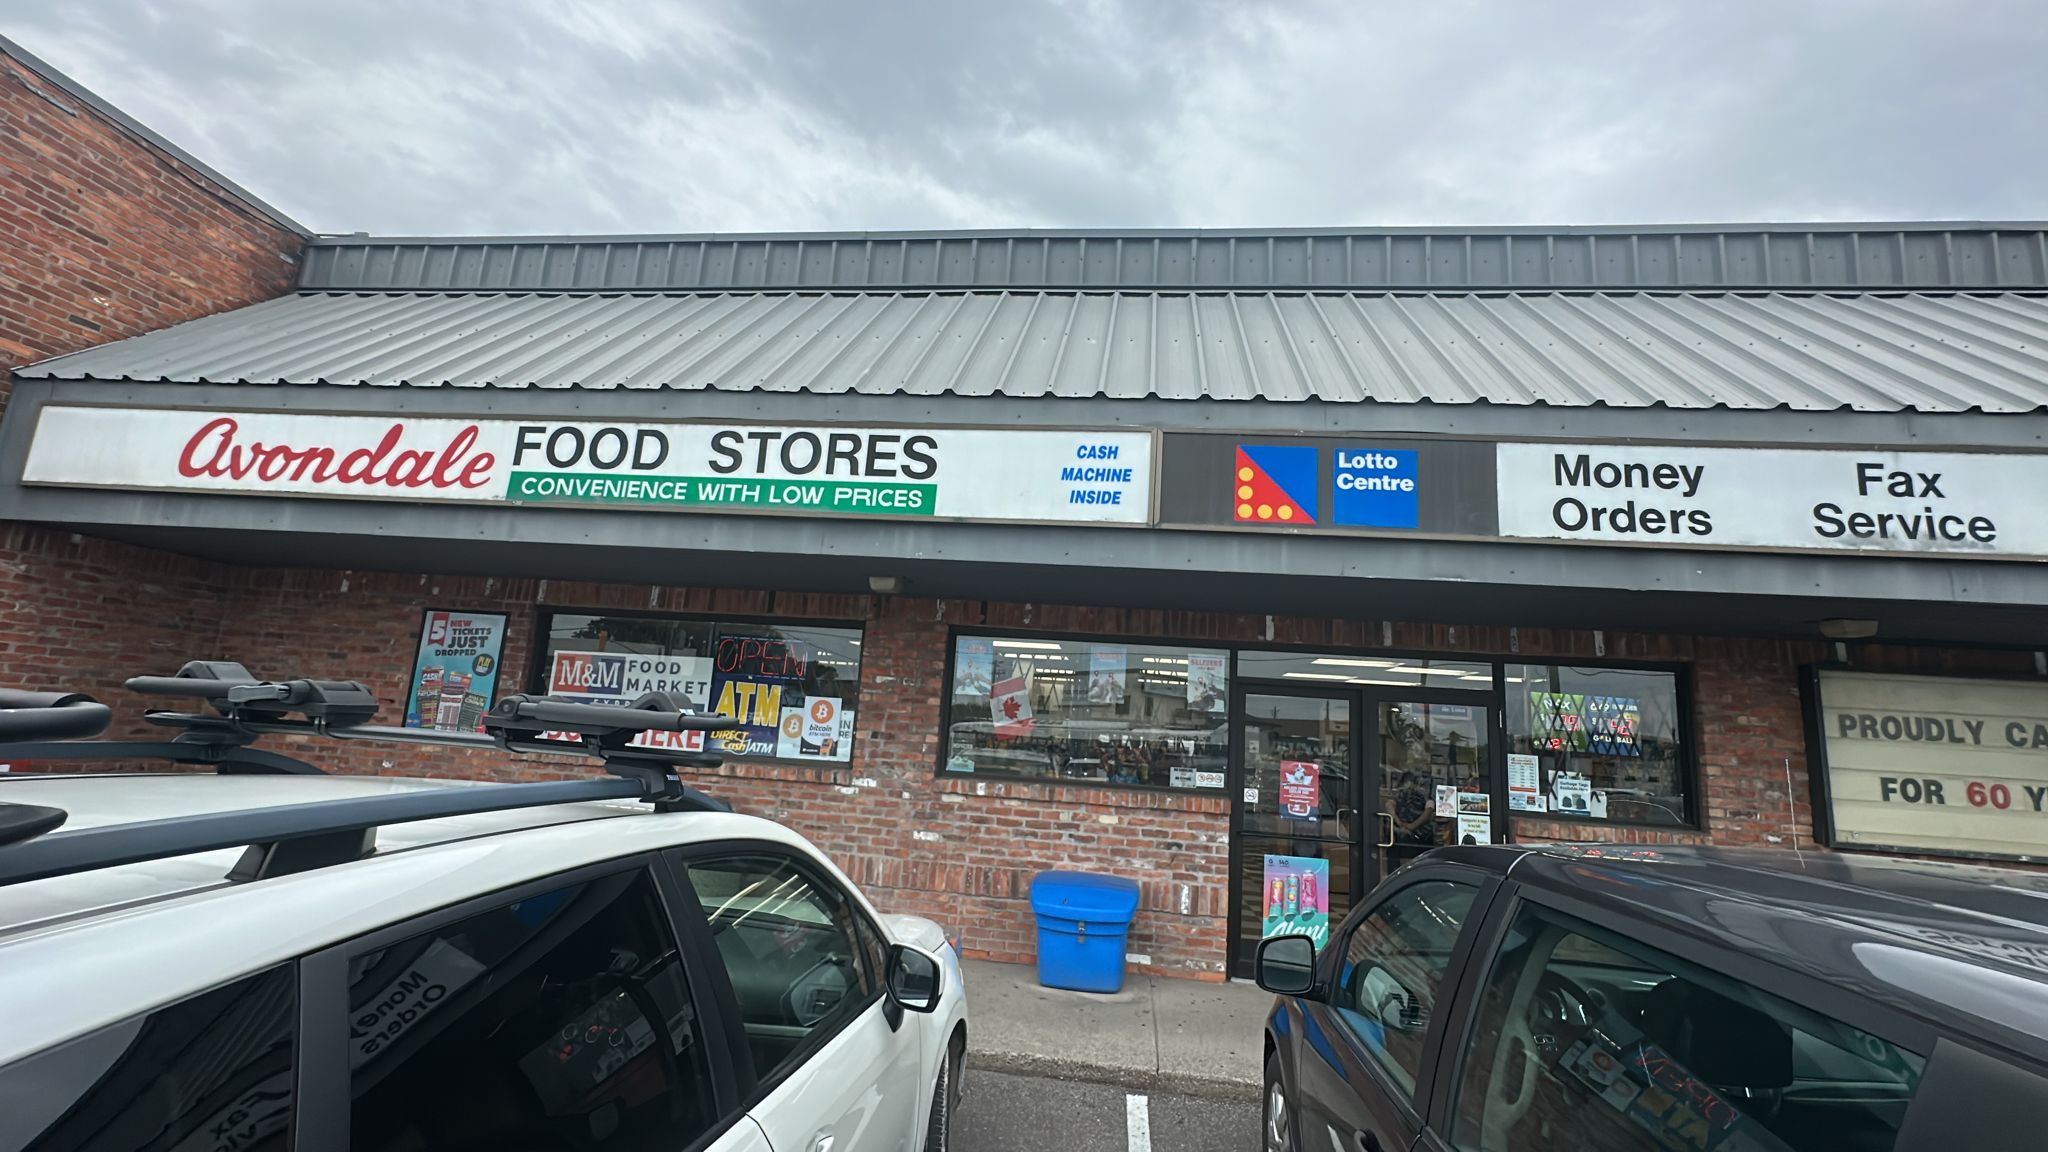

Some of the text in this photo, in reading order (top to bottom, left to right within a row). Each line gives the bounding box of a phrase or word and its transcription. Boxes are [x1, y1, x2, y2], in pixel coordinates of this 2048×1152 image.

[178, 417, 496, 489] Avondale
[512, 425, 938, 480] FOOD STORES
[1076, 445, 1119, 460] CASH
[1338, 452, 1398, 471] Lotto
[1061, 467, 1133, 483] MACHINE
[1336, 473, 1415, 493] Centre
[1554, 454, 1704, 498] Money
[1856, 462, 1946, 499] Fax
[520, 477, 923, 508] CONVENIENCE WITH LOW PRICES
[1069, 489, 1121, 506] INSIDE
[1552, 497, 1713, 535] Orders
[1812, 502, 1997, 543] Service
[430, 620, 446, 641] 5
[452, 628, 492, 636] TICKETS
[448, 636, 488, 649] JUST
[628, 660, 681, 675] FOOD
[717, 639, 806, 677] OPEN
[558, 660, 621, 688] M&M
[626, 678, 707, 695] MARKET
[714, 680, 781, 727] ATM
[710, 730, 749, 741] DIRECT
[809, 723, 832, 732] bitcoin
[1838, 714, 1984, 745] PROUDLY
[722, 740, 773, 754] Cash ATM
[1880, 777, 2048, 812] FOR 60 Y
